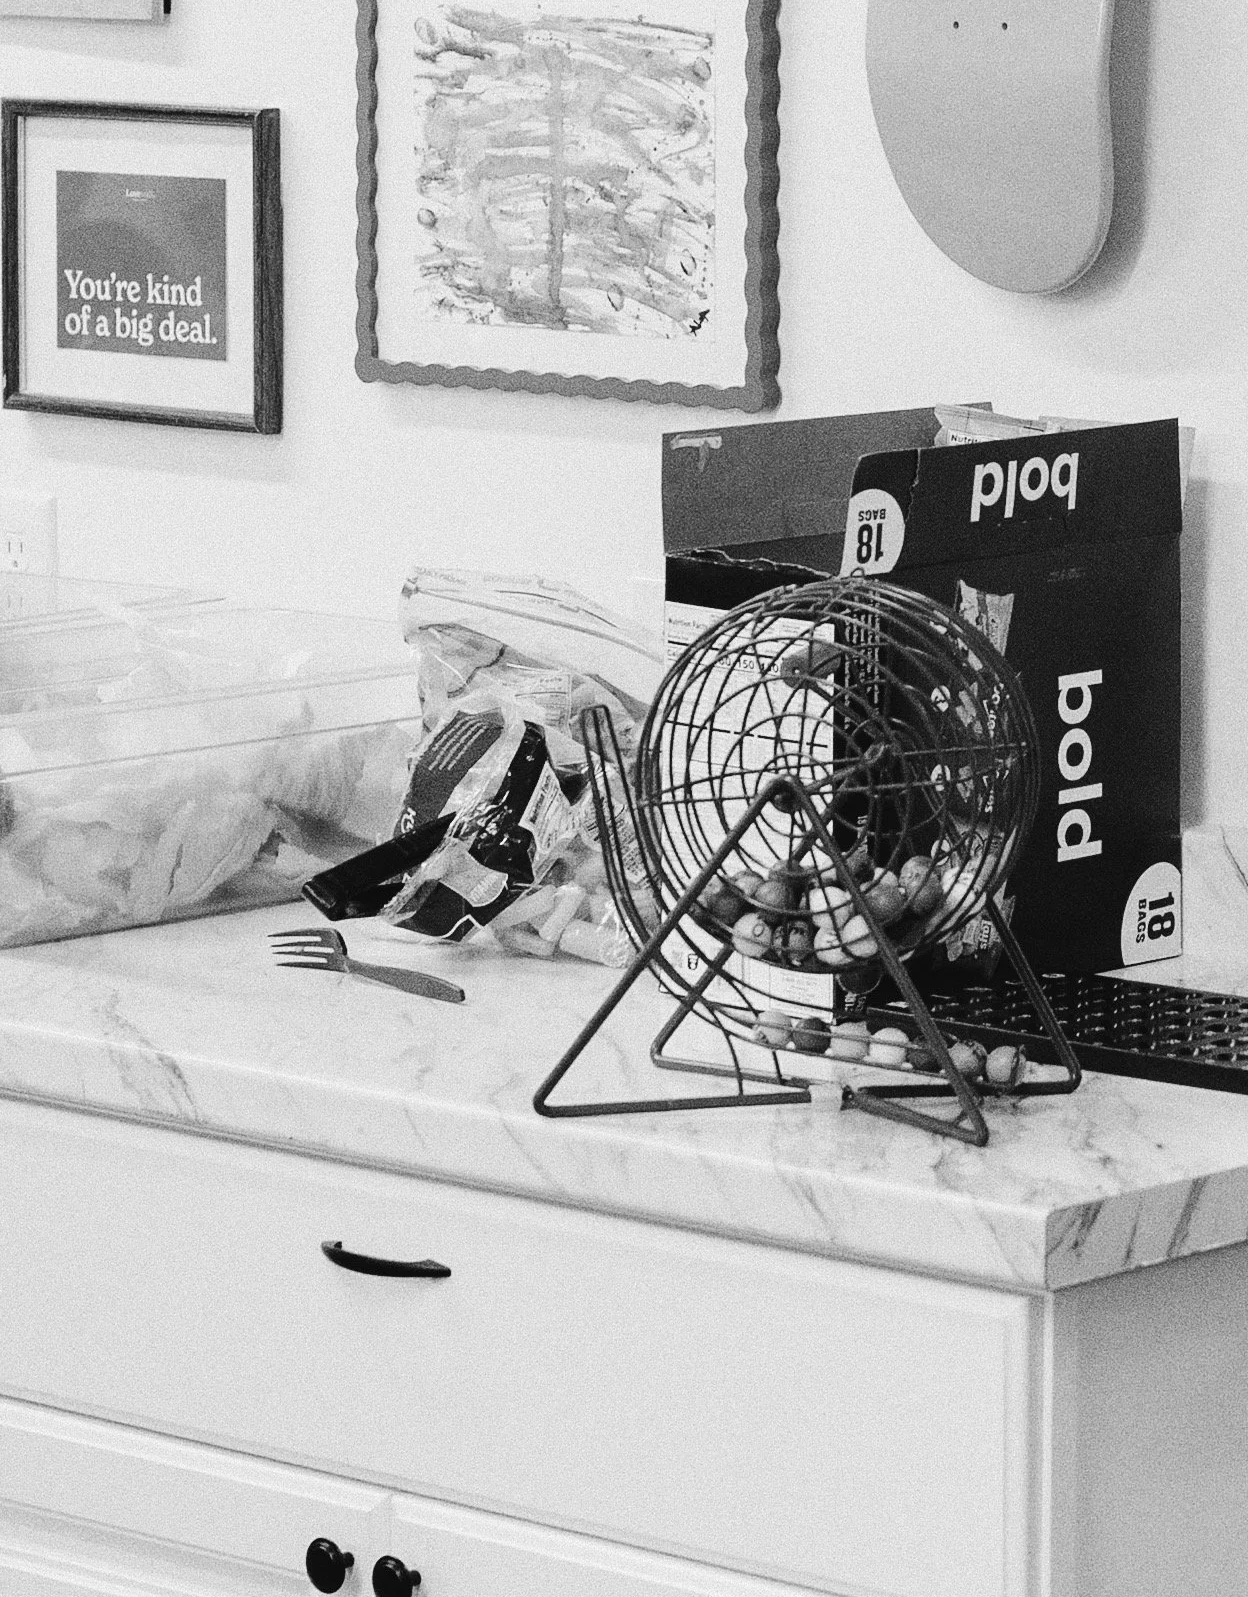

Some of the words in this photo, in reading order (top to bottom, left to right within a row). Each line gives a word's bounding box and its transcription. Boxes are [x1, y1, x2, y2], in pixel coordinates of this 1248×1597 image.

[64, 269, 141, 303] You're
[146, 273, 203, 307] kind
[64, 305, 92, 336] of
[95, 314, 111, 337] a
[114, 307, 154, 346] big
[158, 310, 218, 344] deal.
[970, 452, 1080, 523] bold
[858, 508, 887, 522] BAGS
[856, 523, 884, 564] 18
[1057, 669, 1103, 863] bold
[1135, 898, 1147, 943] BAGS
[1147, 891, 1175, 940] 18
